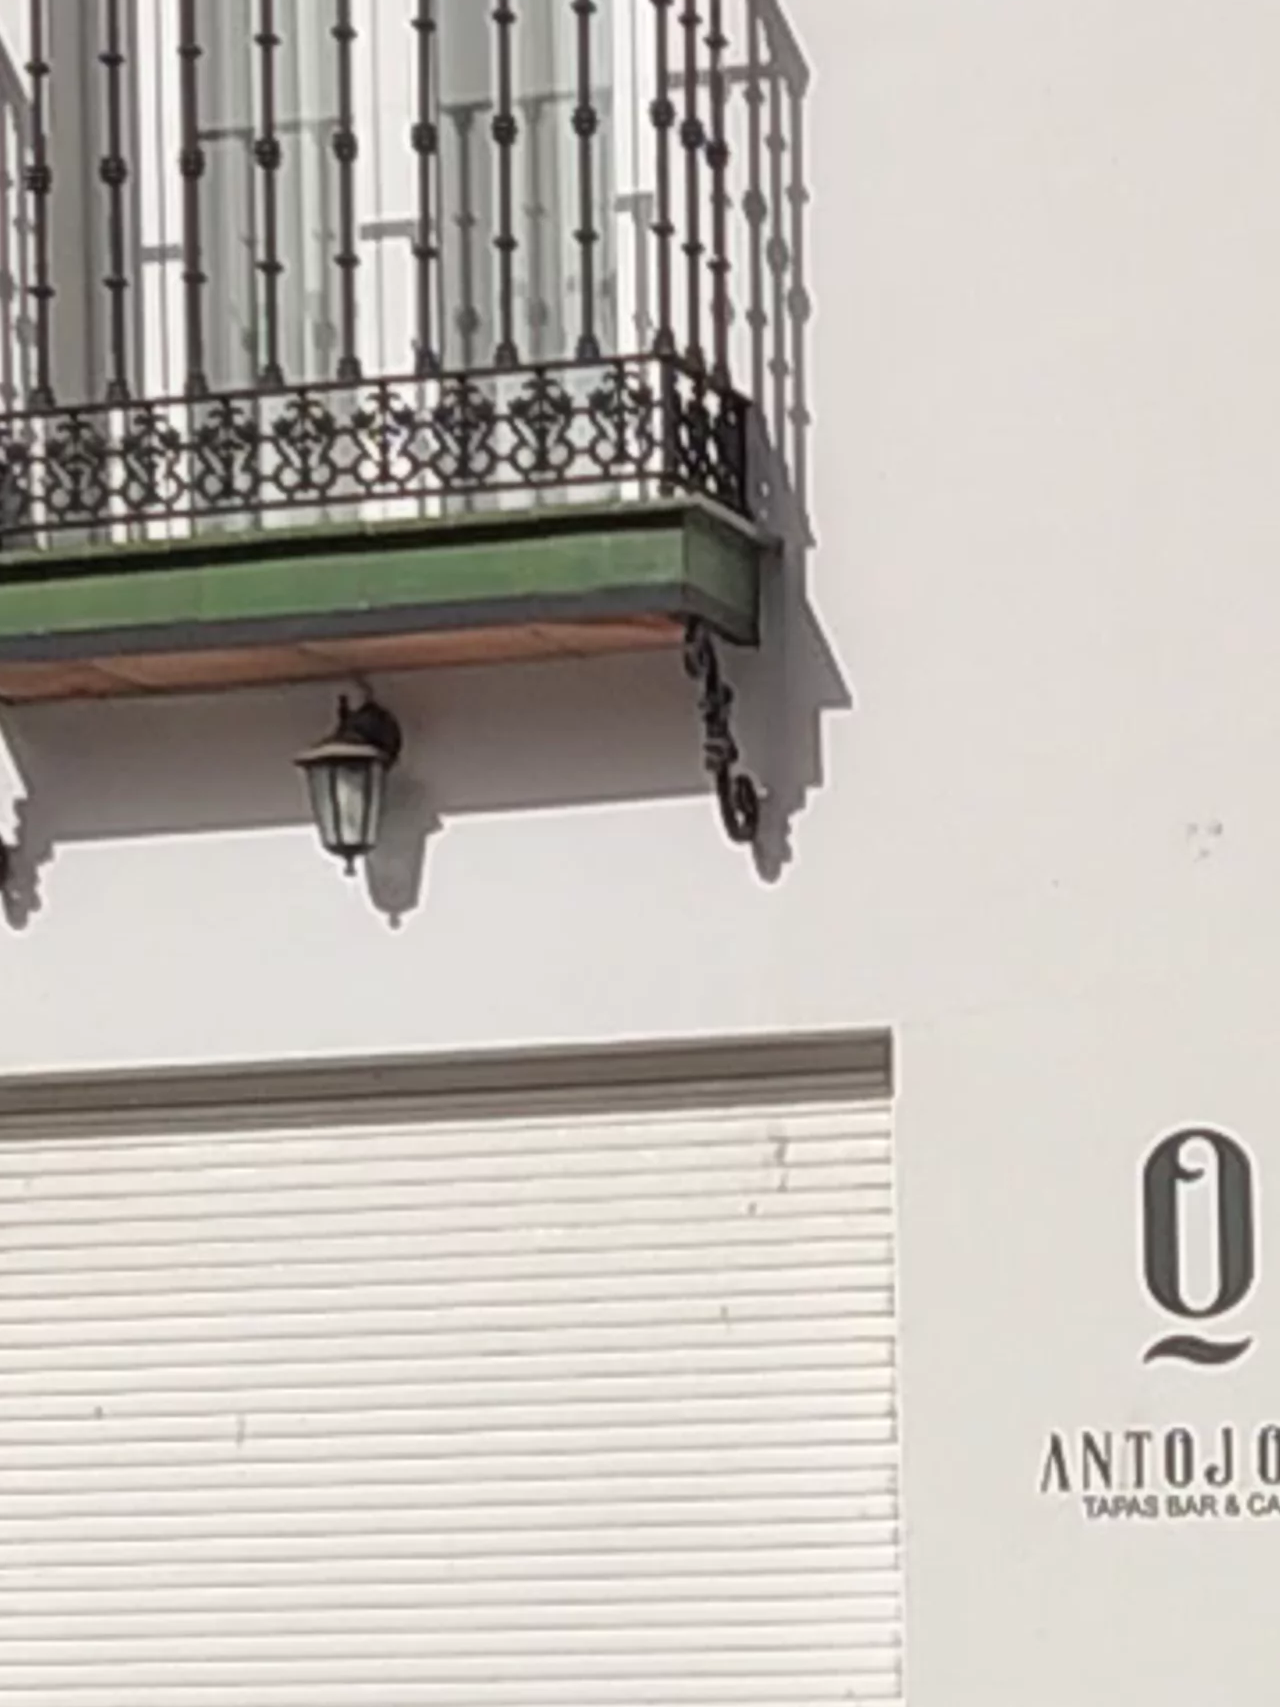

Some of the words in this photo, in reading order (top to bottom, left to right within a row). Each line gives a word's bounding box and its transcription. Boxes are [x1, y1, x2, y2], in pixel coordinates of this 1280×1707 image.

[1082, 1495, 1159, 1519] TAPAS
[1166, 1495, 1218, 1518] BAR
[1225, 1494, 1240, 1516] &
